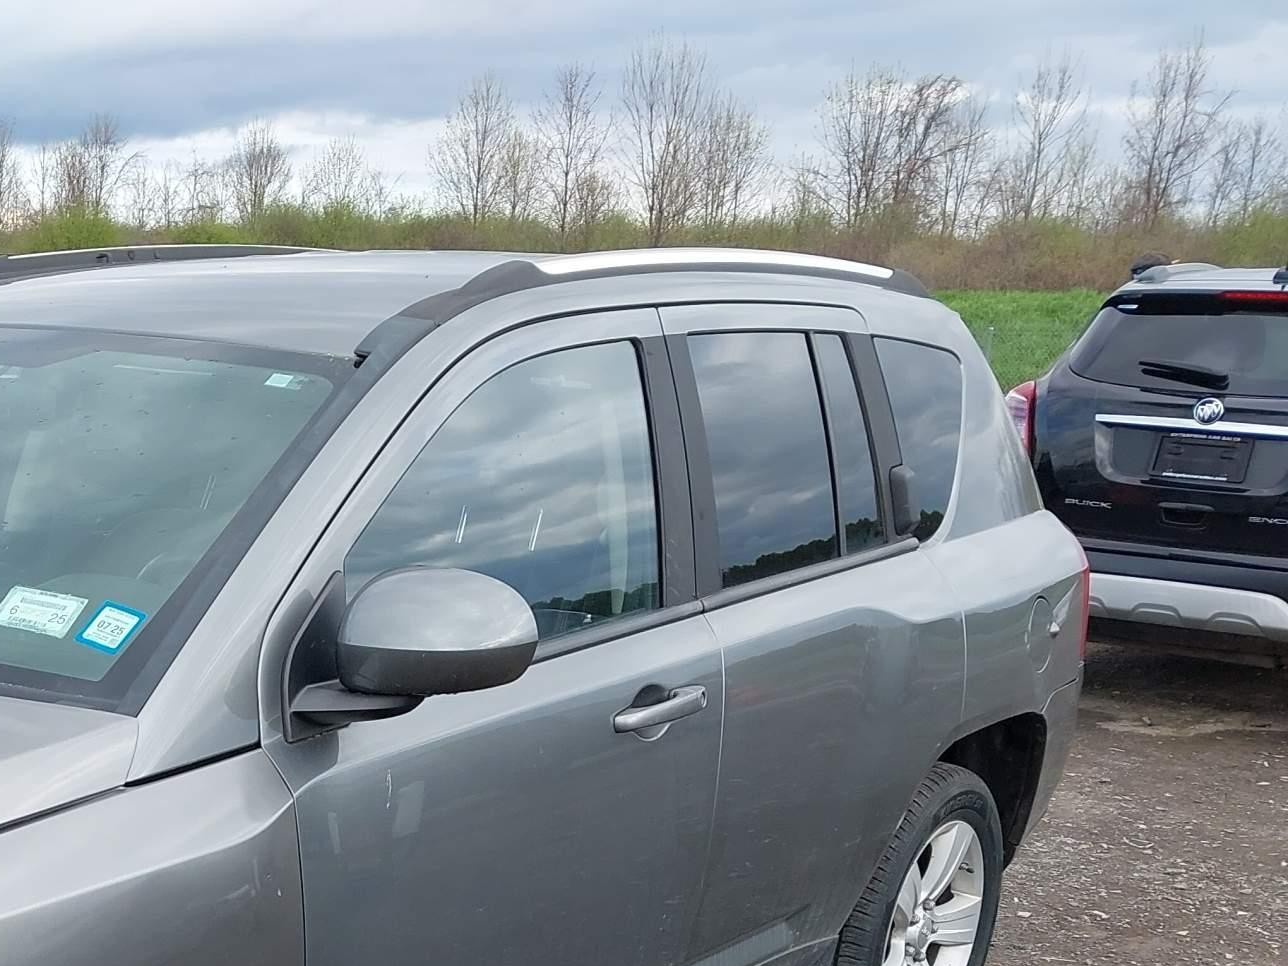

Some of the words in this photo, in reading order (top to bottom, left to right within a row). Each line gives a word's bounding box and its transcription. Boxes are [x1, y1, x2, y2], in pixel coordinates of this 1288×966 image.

[1064, 498, 1113, 509] BUICK
[9, 605, 20, 615] 6
[48, 613, 68, 625] 25
